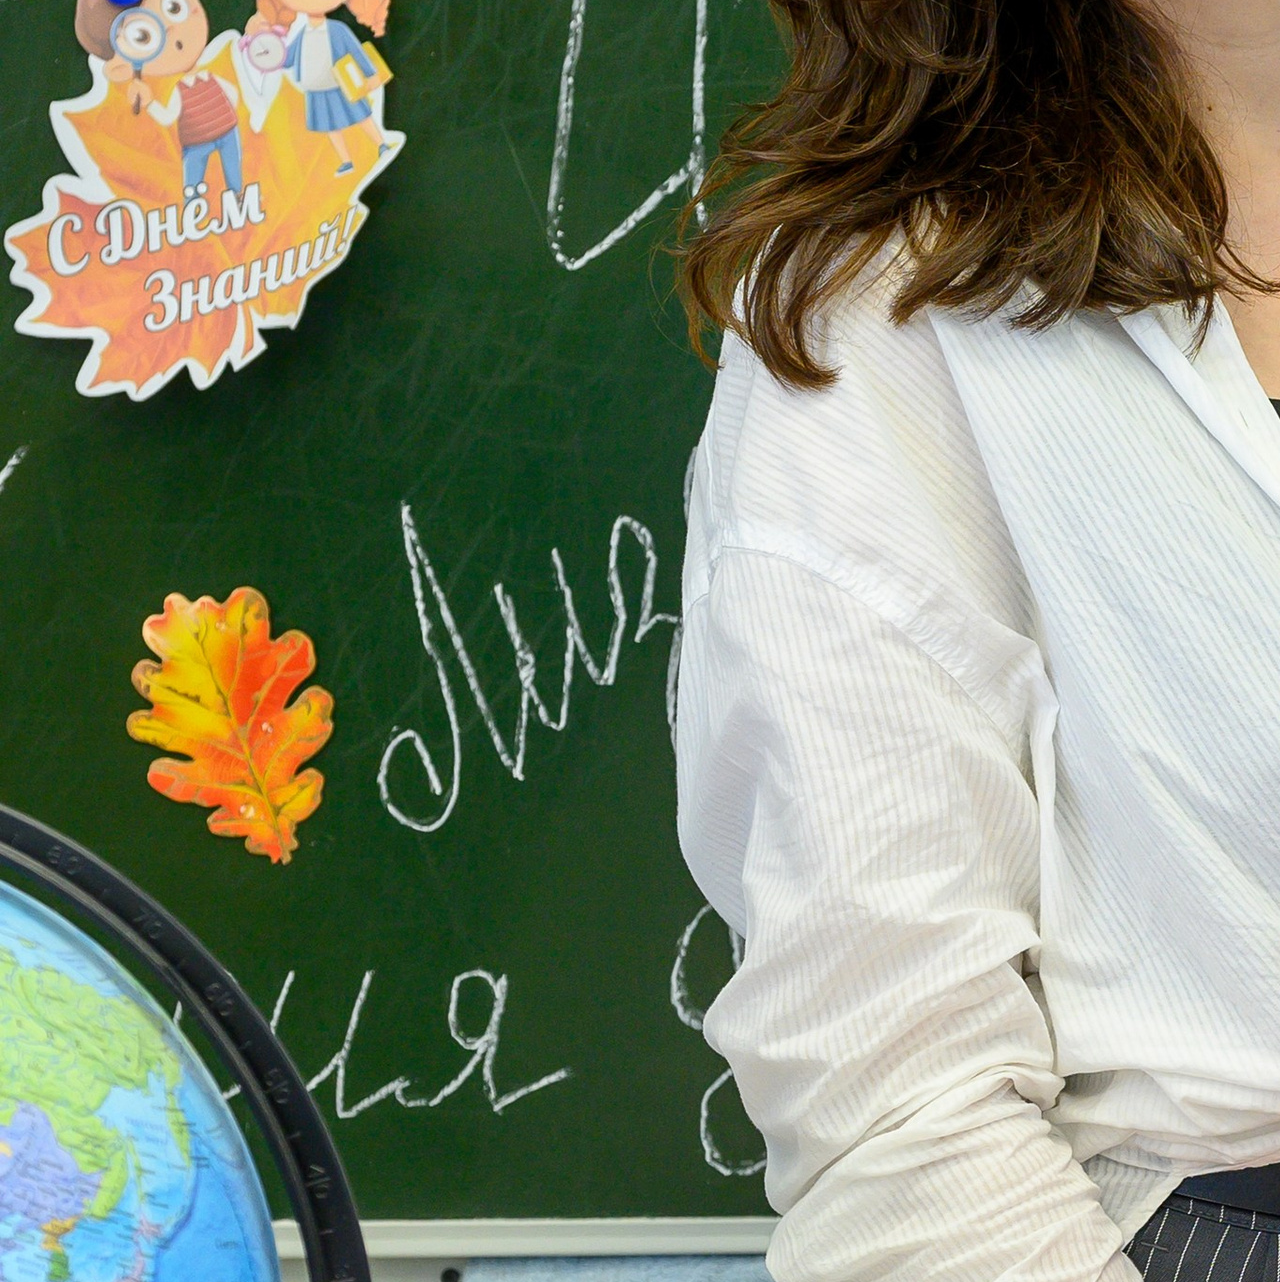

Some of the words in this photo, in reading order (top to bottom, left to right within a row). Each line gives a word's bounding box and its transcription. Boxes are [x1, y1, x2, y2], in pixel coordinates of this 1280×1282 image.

[47, 213, 90, 277] С
[95, 181, 266, 266] Днём
[143, 203, 359, 333] Знаний!
